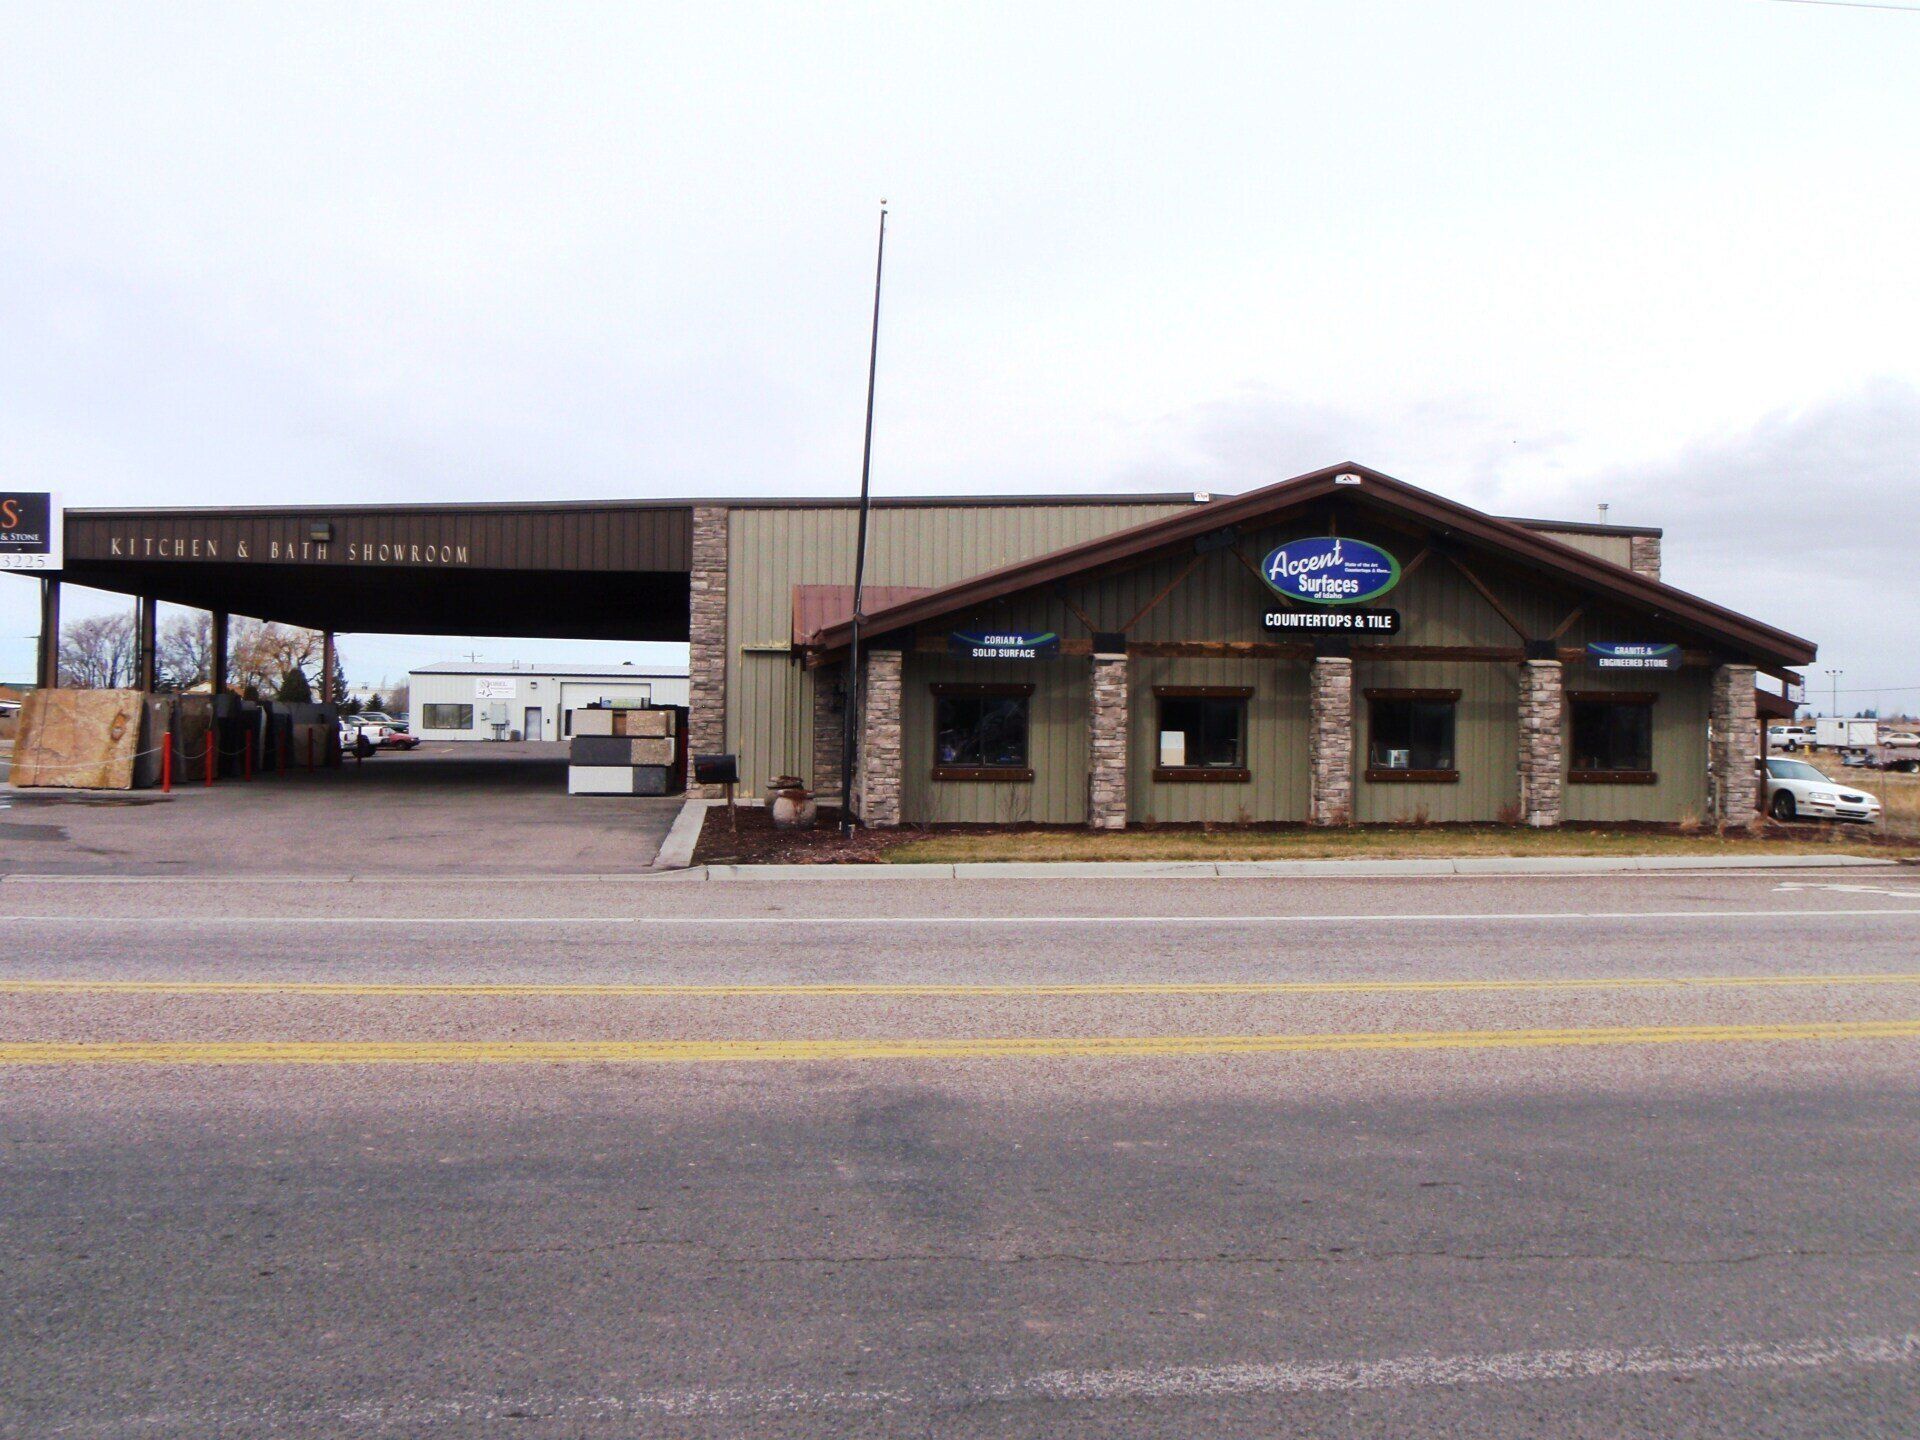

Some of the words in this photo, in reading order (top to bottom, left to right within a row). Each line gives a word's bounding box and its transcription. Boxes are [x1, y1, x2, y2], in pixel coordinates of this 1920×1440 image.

[0, 533, 8, 541] &
[10, 533, 40, 541] STONE
[111, 537, 218, 557] KITCHEN
[237, 541, 248, 558] &
[271, 541, 328, 560] BATH
[349, 543, 468, 563] SHOWROOM
[2, 554, 46, 568] 3225
[1269, 539, 1344, 580] Accent
[1298, 574, 1359, 593] Surfaces
[1265, 613, 1351, 627] COUNTERTOPS
[1354, 615, 1364, 628] &
[1367, 615, 1392, 629] TILE
[984, 636, 1015, 645] CORIAN
[1017, 636, 1024, 645] &
[972, 648, 997, 658] SOLID
[998, 649, 1036, 658] SURFACE
[1614, 646, 1645, 655] GRANITE
[1599, 658, 1643, 667] ENGINEERED
[1644, 659, 1669, 667] STONE
